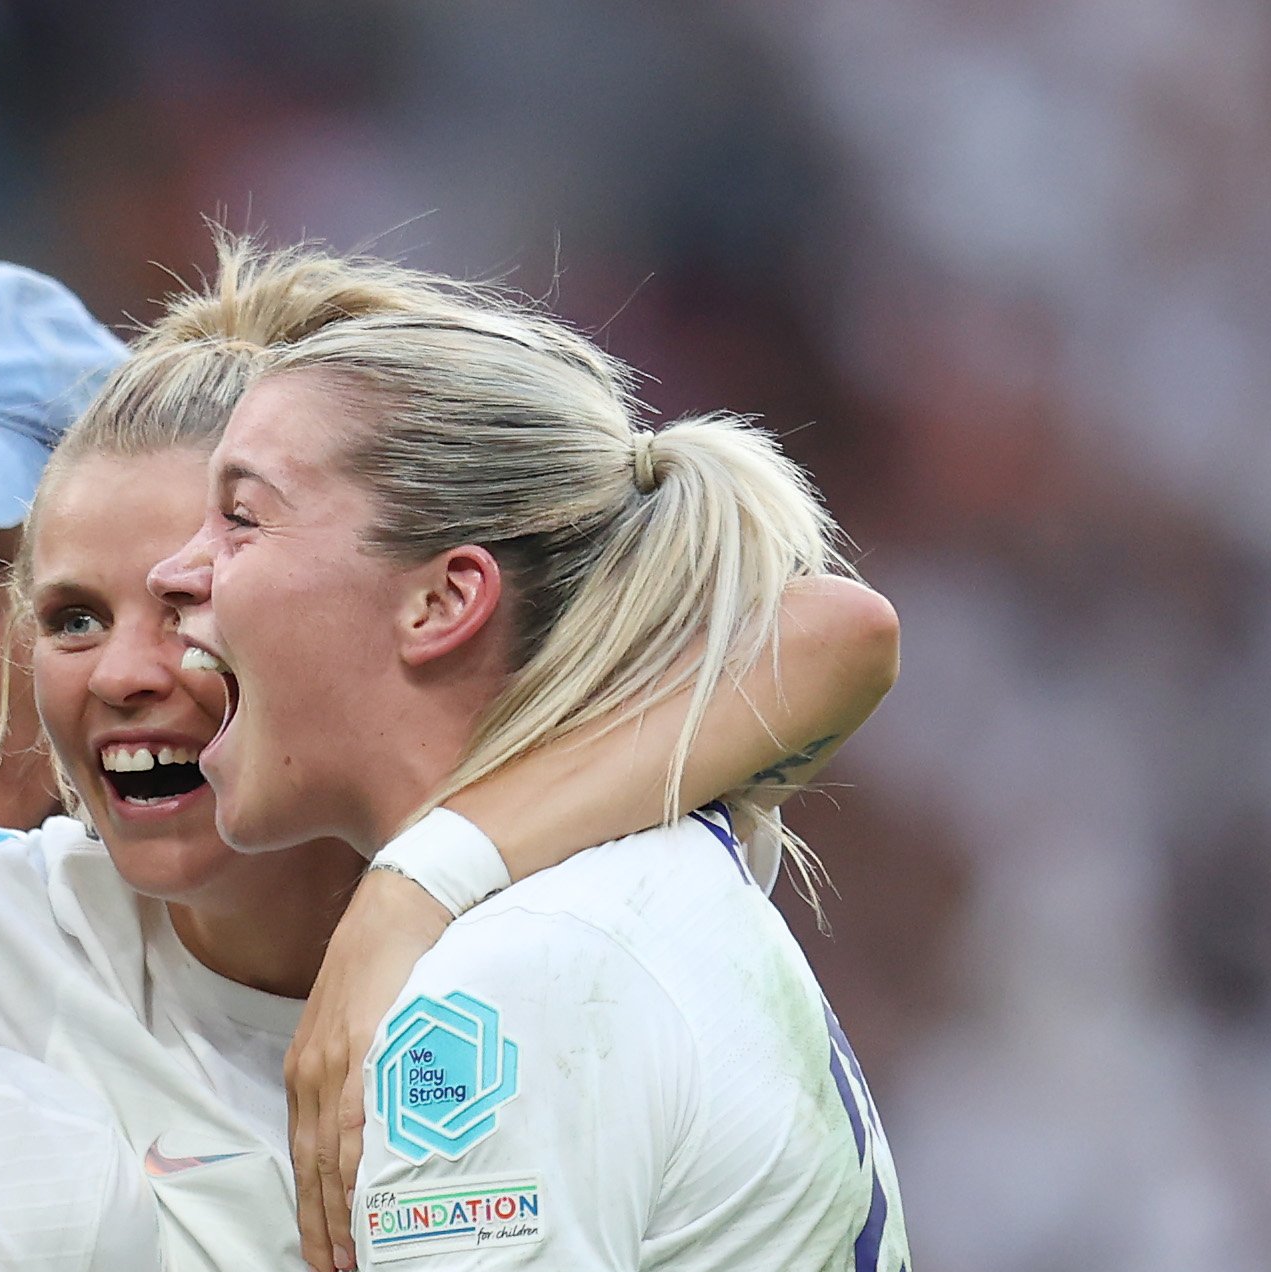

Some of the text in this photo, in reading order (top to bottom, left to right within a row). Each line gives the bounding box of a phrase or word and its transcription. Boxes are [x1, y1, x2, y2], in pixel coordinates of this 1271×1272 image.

[409, 1048, 433, 1064] We
[409, 1085, 466, 1103] Strong
[366, 1192, 397, 1209] UEFA
[478, 1224, 539, 1245] for children
